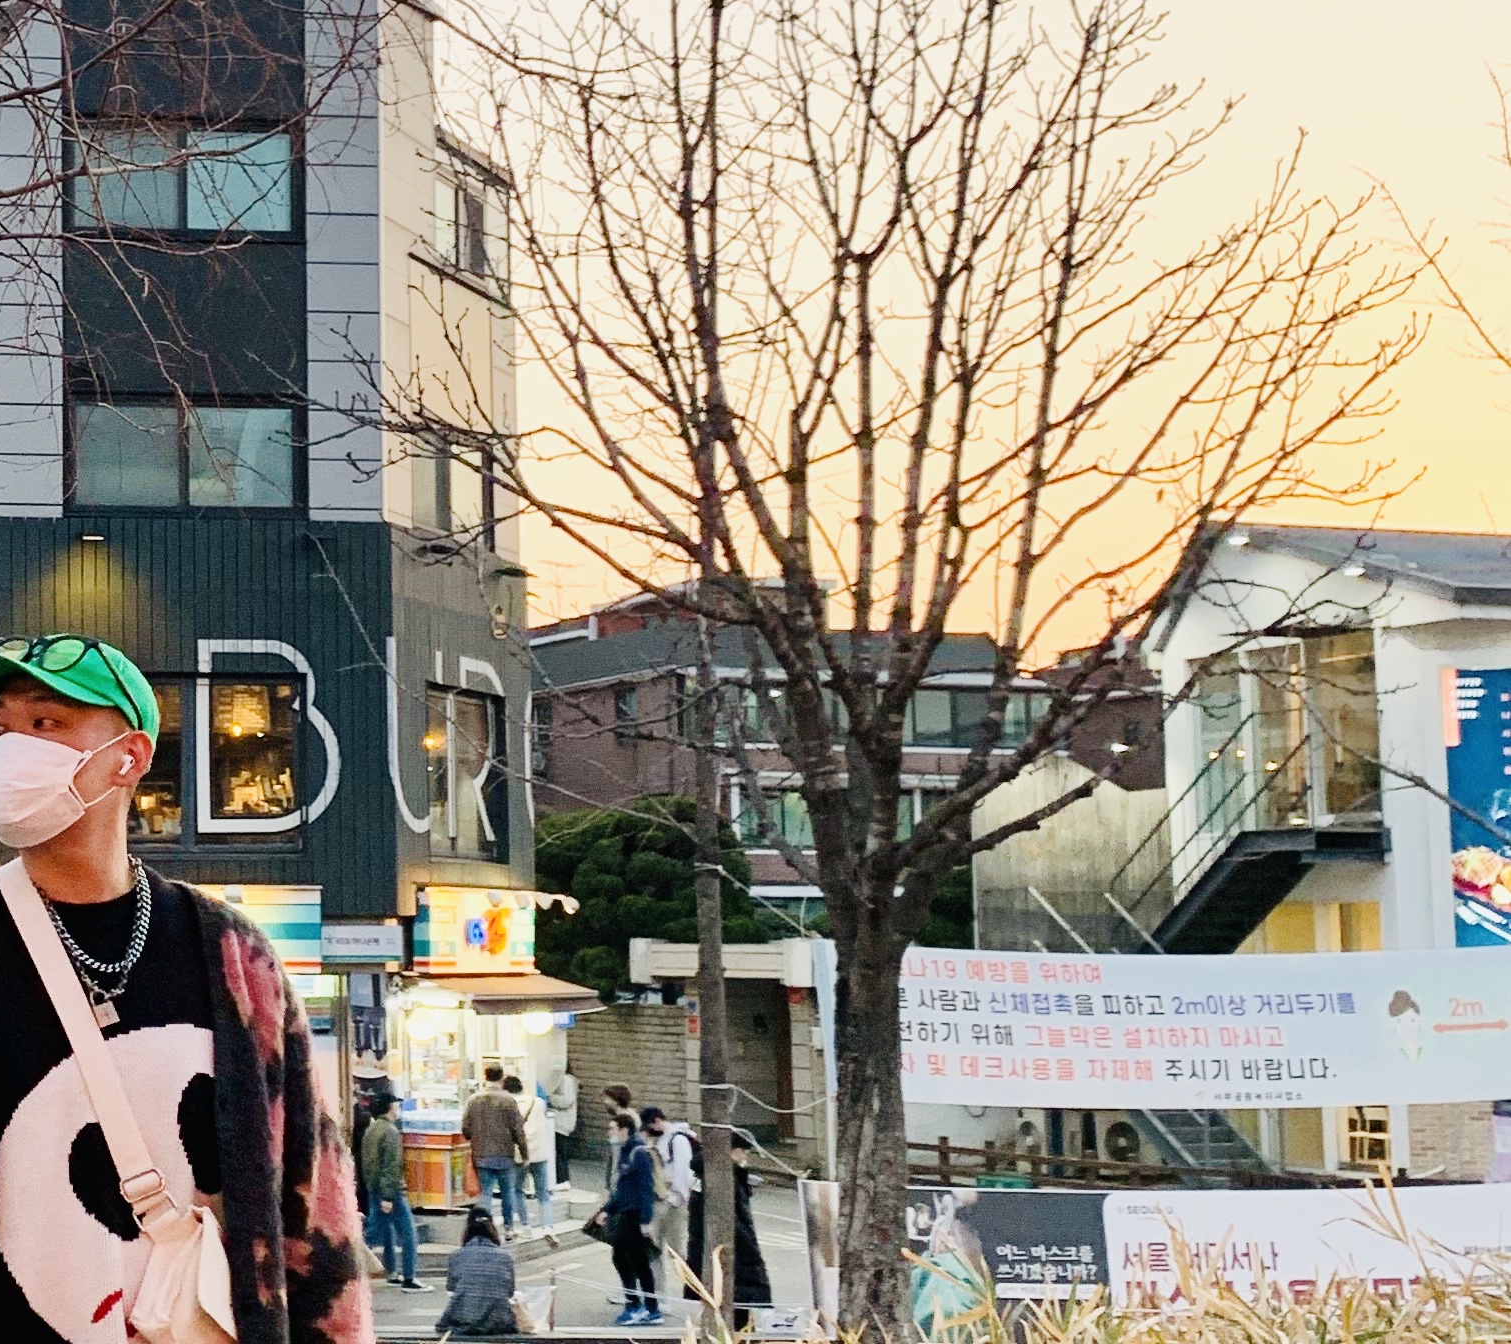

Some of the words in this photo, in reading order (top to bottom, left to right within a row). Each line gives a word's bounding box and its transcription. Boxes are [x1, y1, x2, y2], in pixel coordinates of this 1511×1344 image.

[195, 636, 534, 843] BUR
[966, 959, 1030, 984] 예방을
[1041, 961, 1102, 985] 위하여
[918, 988, 980, 1012] 사람과
[990, 992, 1094, 1016] 신체접촉을
[1102, 994, 1165, 1017] 피하고
[1171, 994, 1246, 1017] 2m이상
[1254, 992, 1356, 1016] 거리두기를
[1448, 997, 1483, 1016] 2m
[971, 1023, 1014, 1046] 위해
[1025, 1024, 1114, 1049] 그늘막은
[1123, 1025, 1210, 1050] 설치하지
[1220, 1025, 1284, 1049] 마시고
[927, 1054, 946, 1076] 및
[961, 1054, 1075, 1081] 데크사용을
[1088, 1057, 1153, 1081] 자제해
[1165, 1058, 1229, 1082] 주시기
[1240, 1057, 1337, 1081] 바랍니다.
[996, 1244, 1028, 1260] 어느
[1030, 1244, 1094, 1263] 마스크를
[1123, 1242, 1170, 1272] 서울
[996, 1262, 1098, 1282] 쓰시겠습니까?
